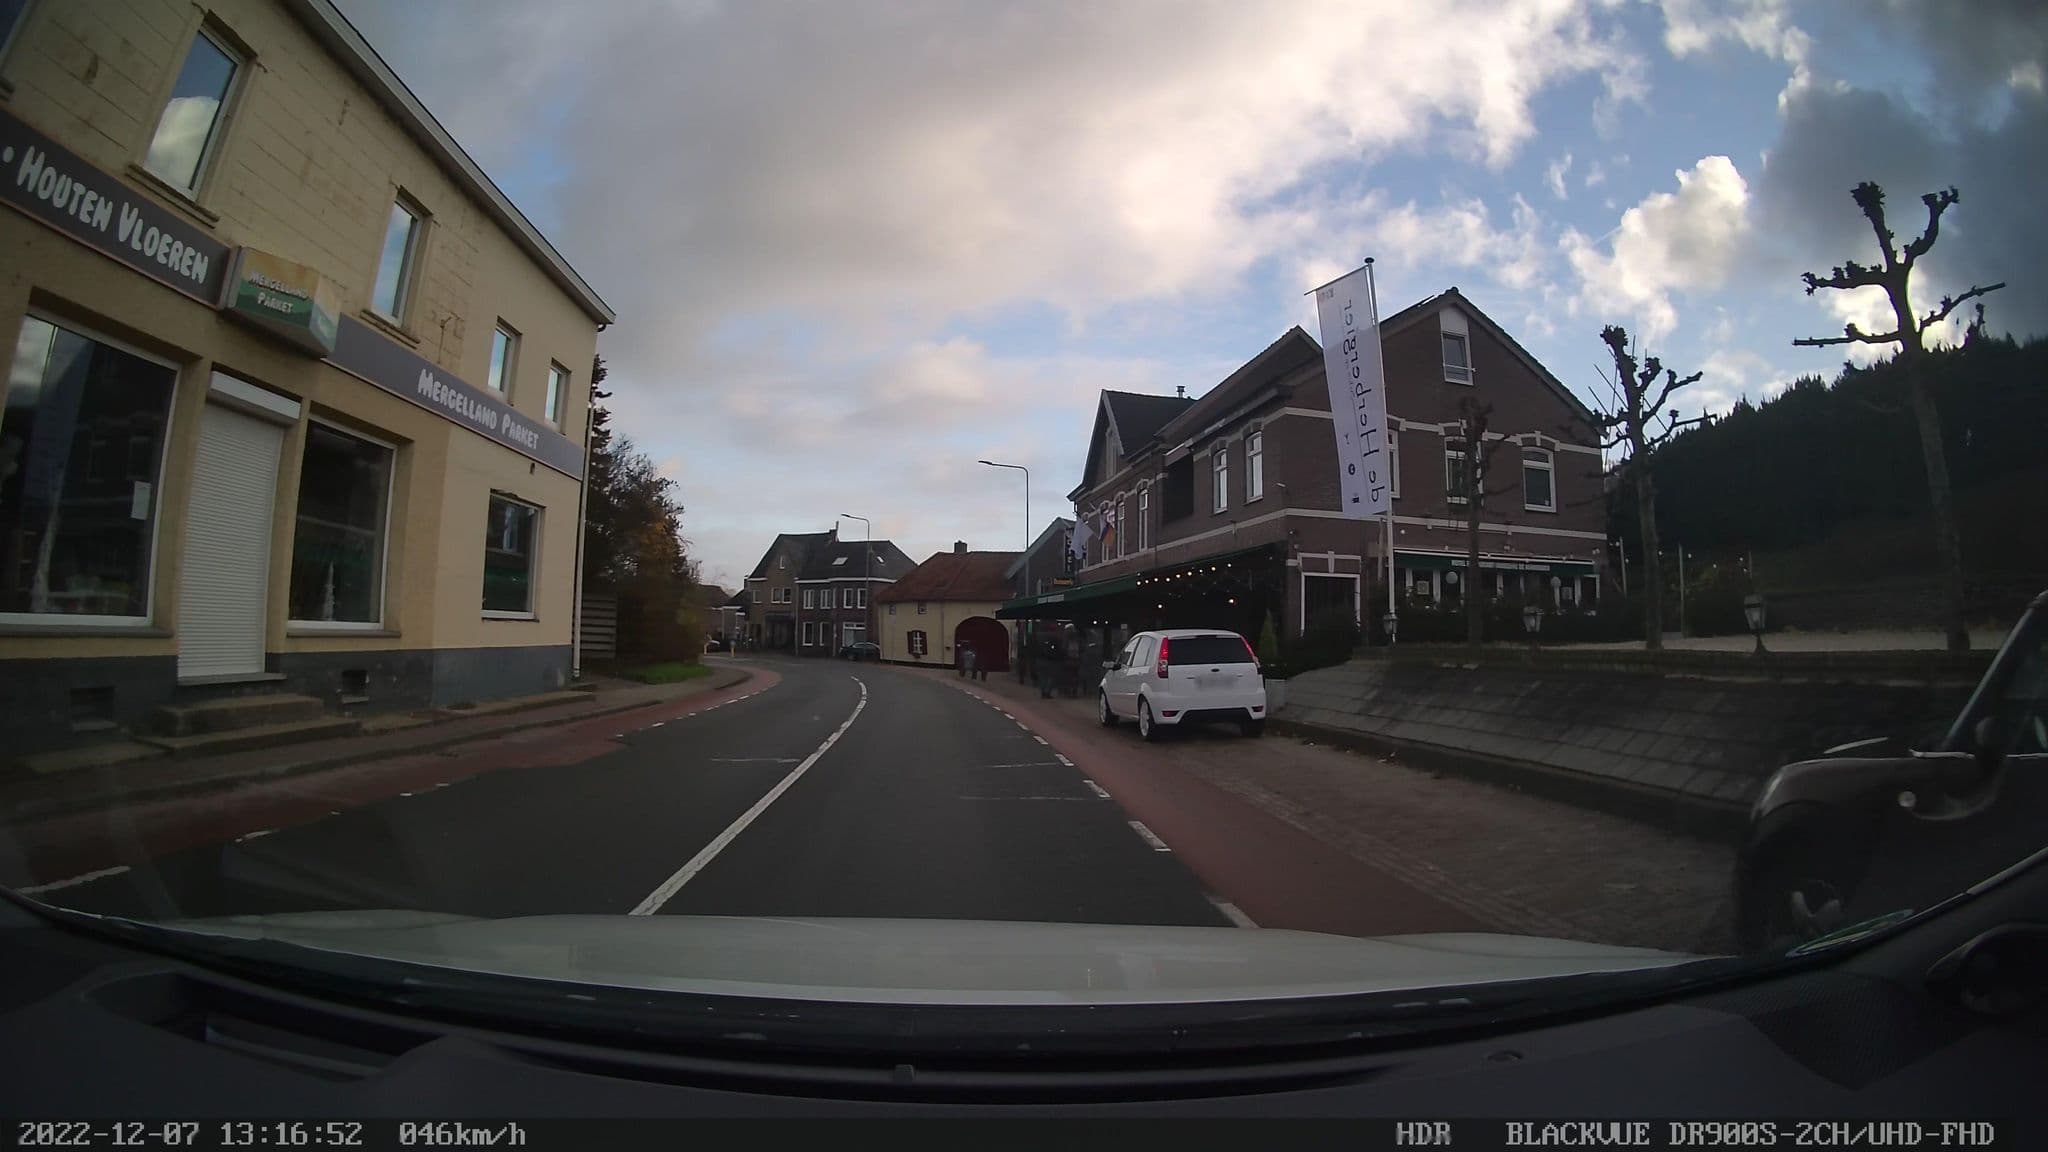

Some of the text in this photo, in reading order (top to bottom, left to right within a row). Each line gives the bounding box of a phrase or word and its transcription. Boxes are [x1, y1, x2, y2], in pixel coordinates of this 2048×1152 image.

[17, 146, 209, 284] HOUTEN VLOEREN
[258, 292, 294, 313] PARKET
[418, 368, 539, 450] MERGELLAND PARKET
